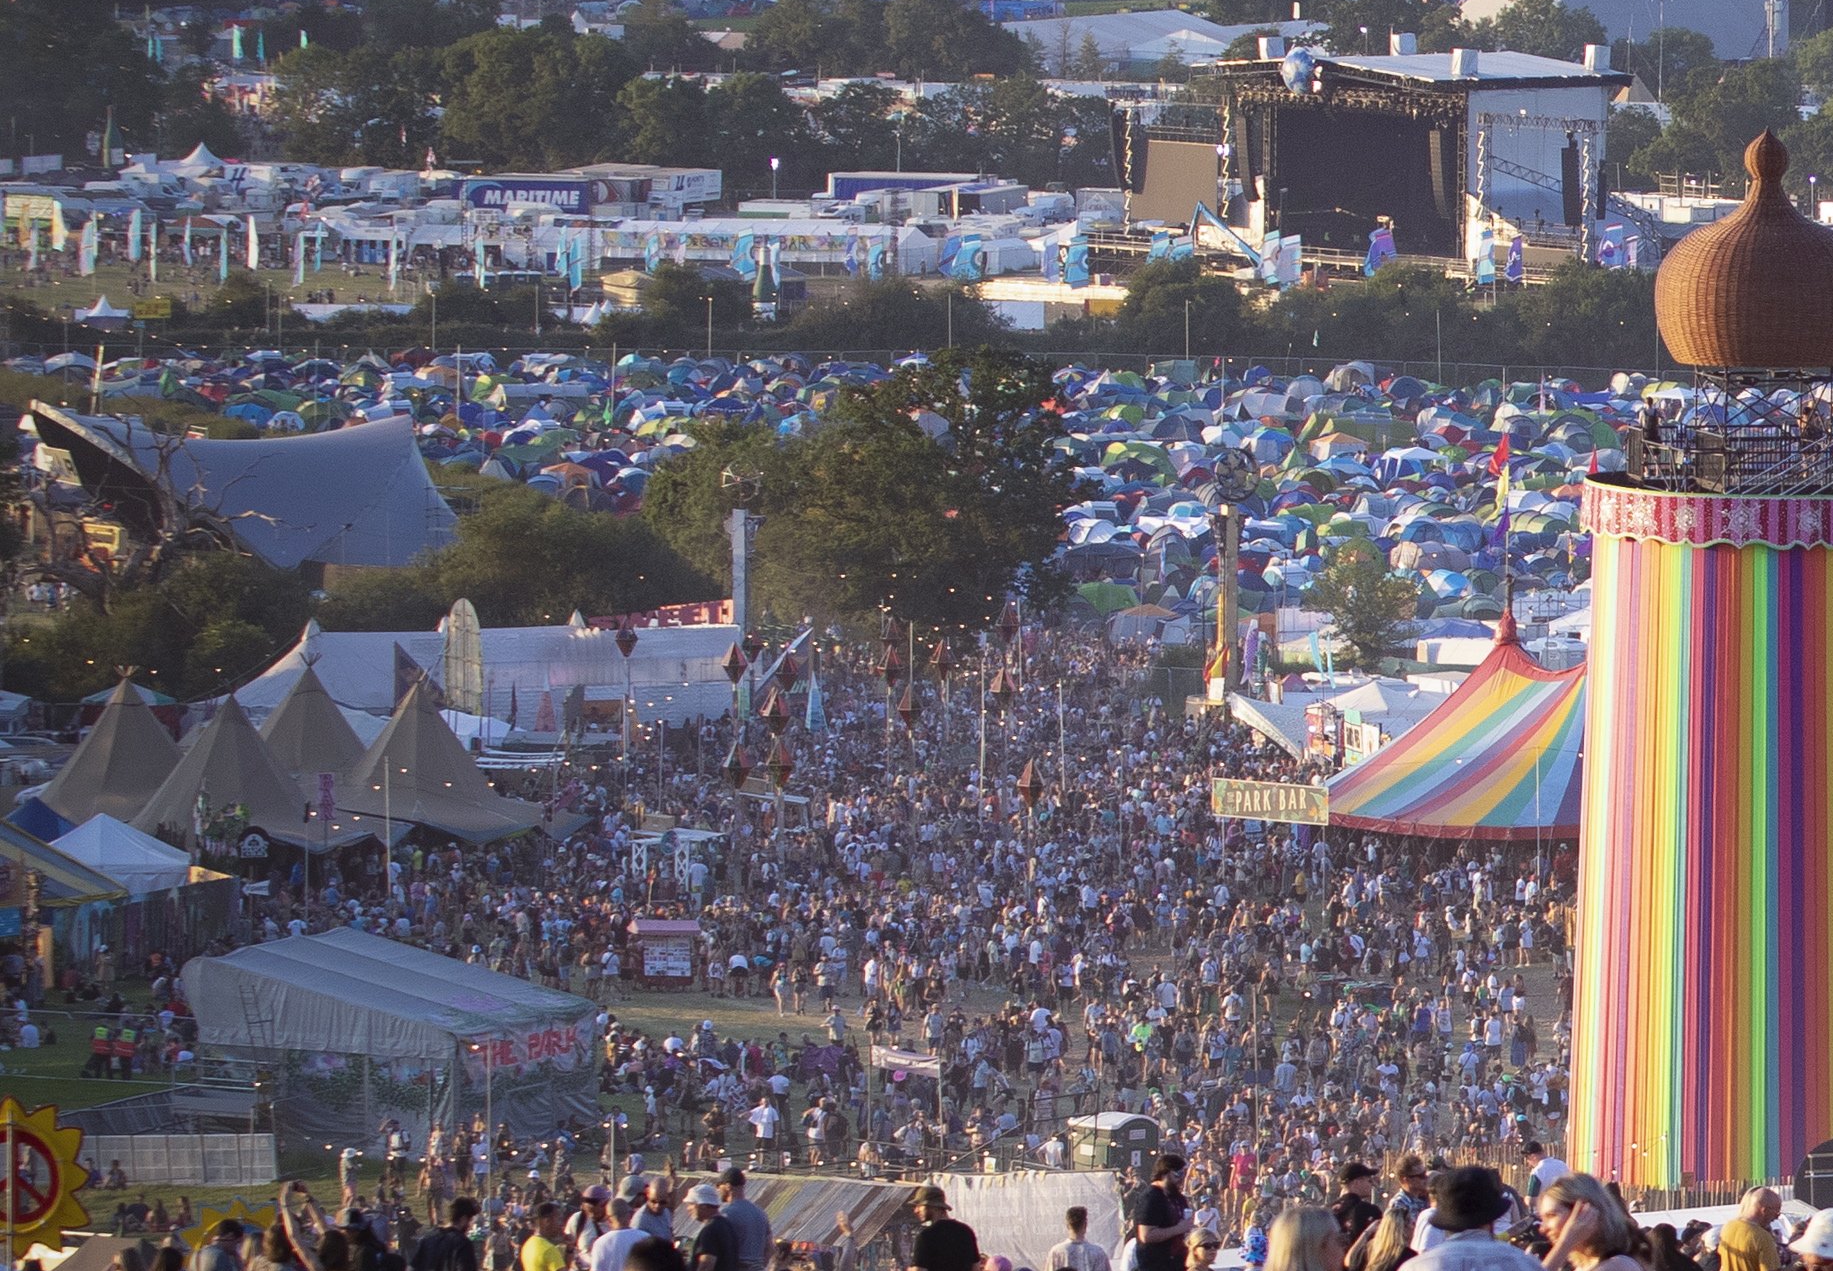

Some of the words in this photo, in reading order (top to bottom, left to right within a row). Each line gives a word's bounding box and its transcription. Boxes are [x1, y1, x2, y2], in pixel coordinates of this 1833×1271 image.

[484, 190, 580, 204] MARITIME
[1235, 790, 1271, 812] PARK
[1279, 789, 1307, 811] BAR
